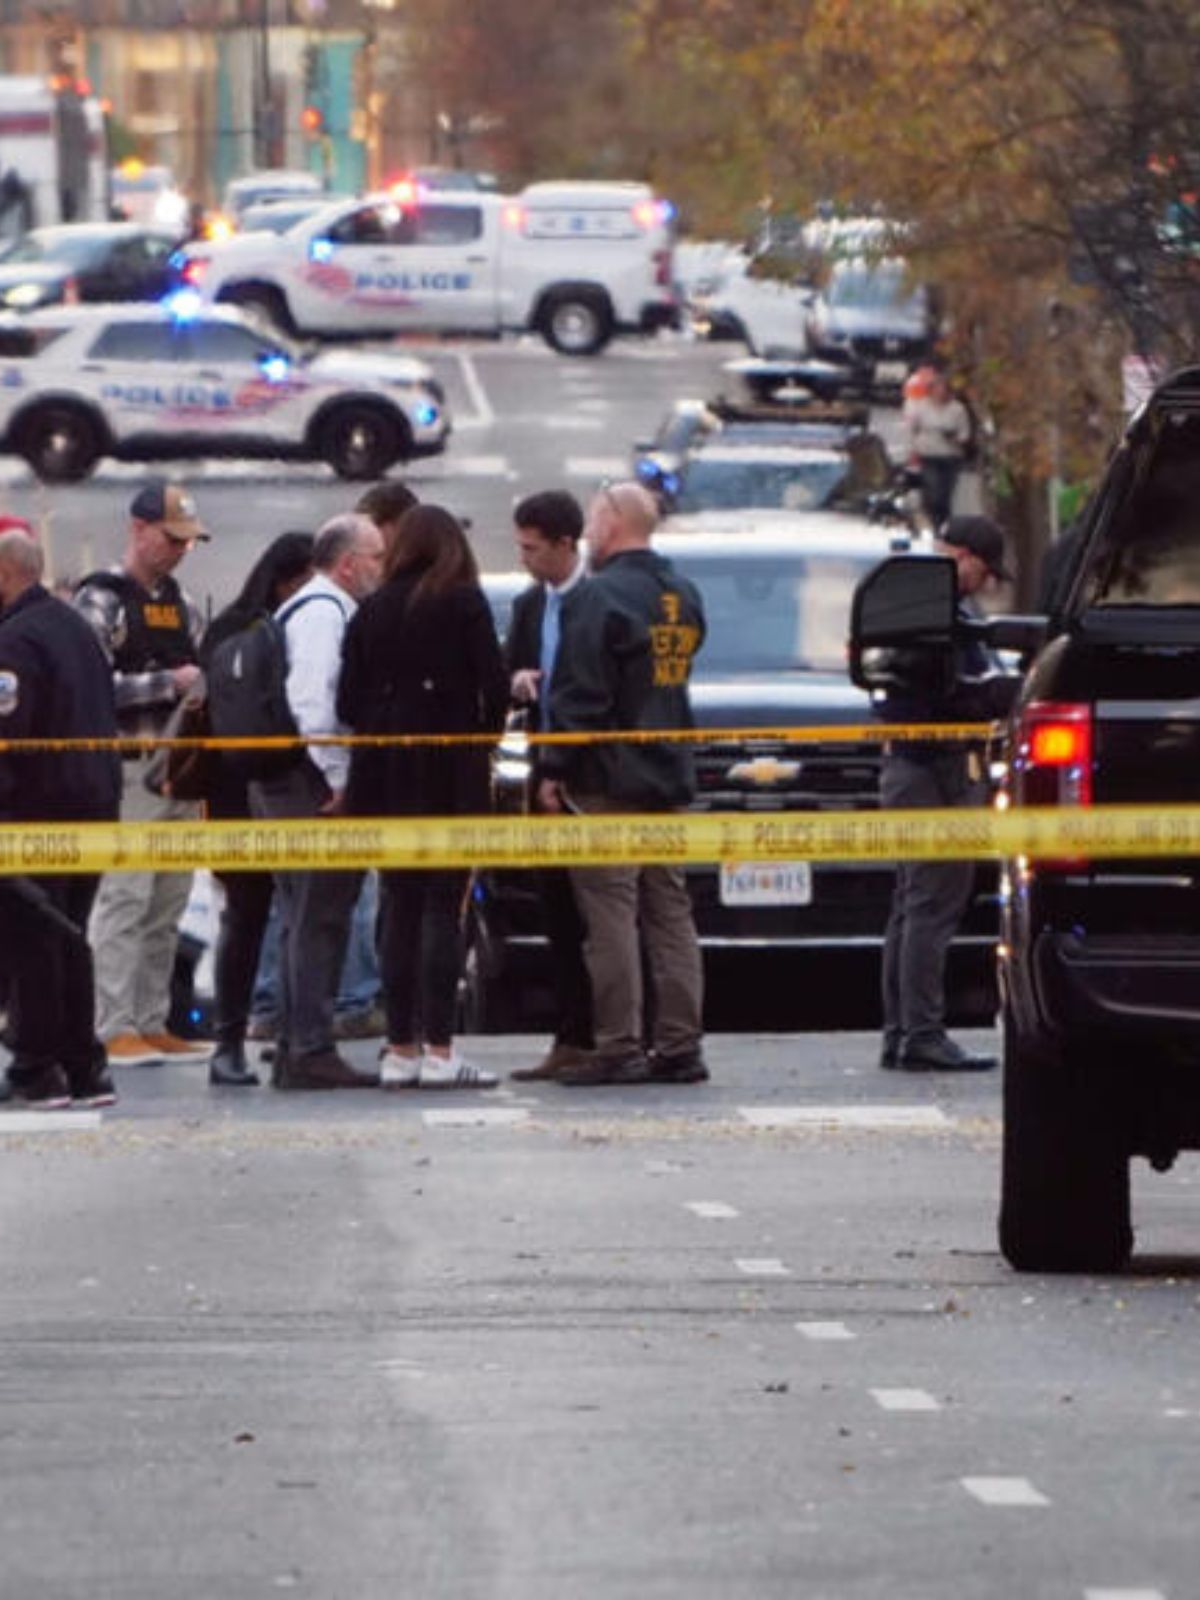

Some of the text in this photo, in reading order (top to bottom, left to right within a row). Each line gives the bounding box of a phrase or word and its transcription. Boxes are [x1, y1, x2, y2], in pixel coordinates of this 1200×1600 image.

[356, 270, 473, 291] POLICE
[101, 383, 231, 409] POLICE
[21, 833, 80, 866] CROSS
[149, 830, 206, 862] POLICE
[212, 830, 248, 862] LINE
[255, 830, 278, 862] DO
[286, 829, 317, 861] NOT
[325, 828, 382, 860] CROSS
[629, 824, 688, 856] CROSS
[754, 822, 816, 855] POLICE
